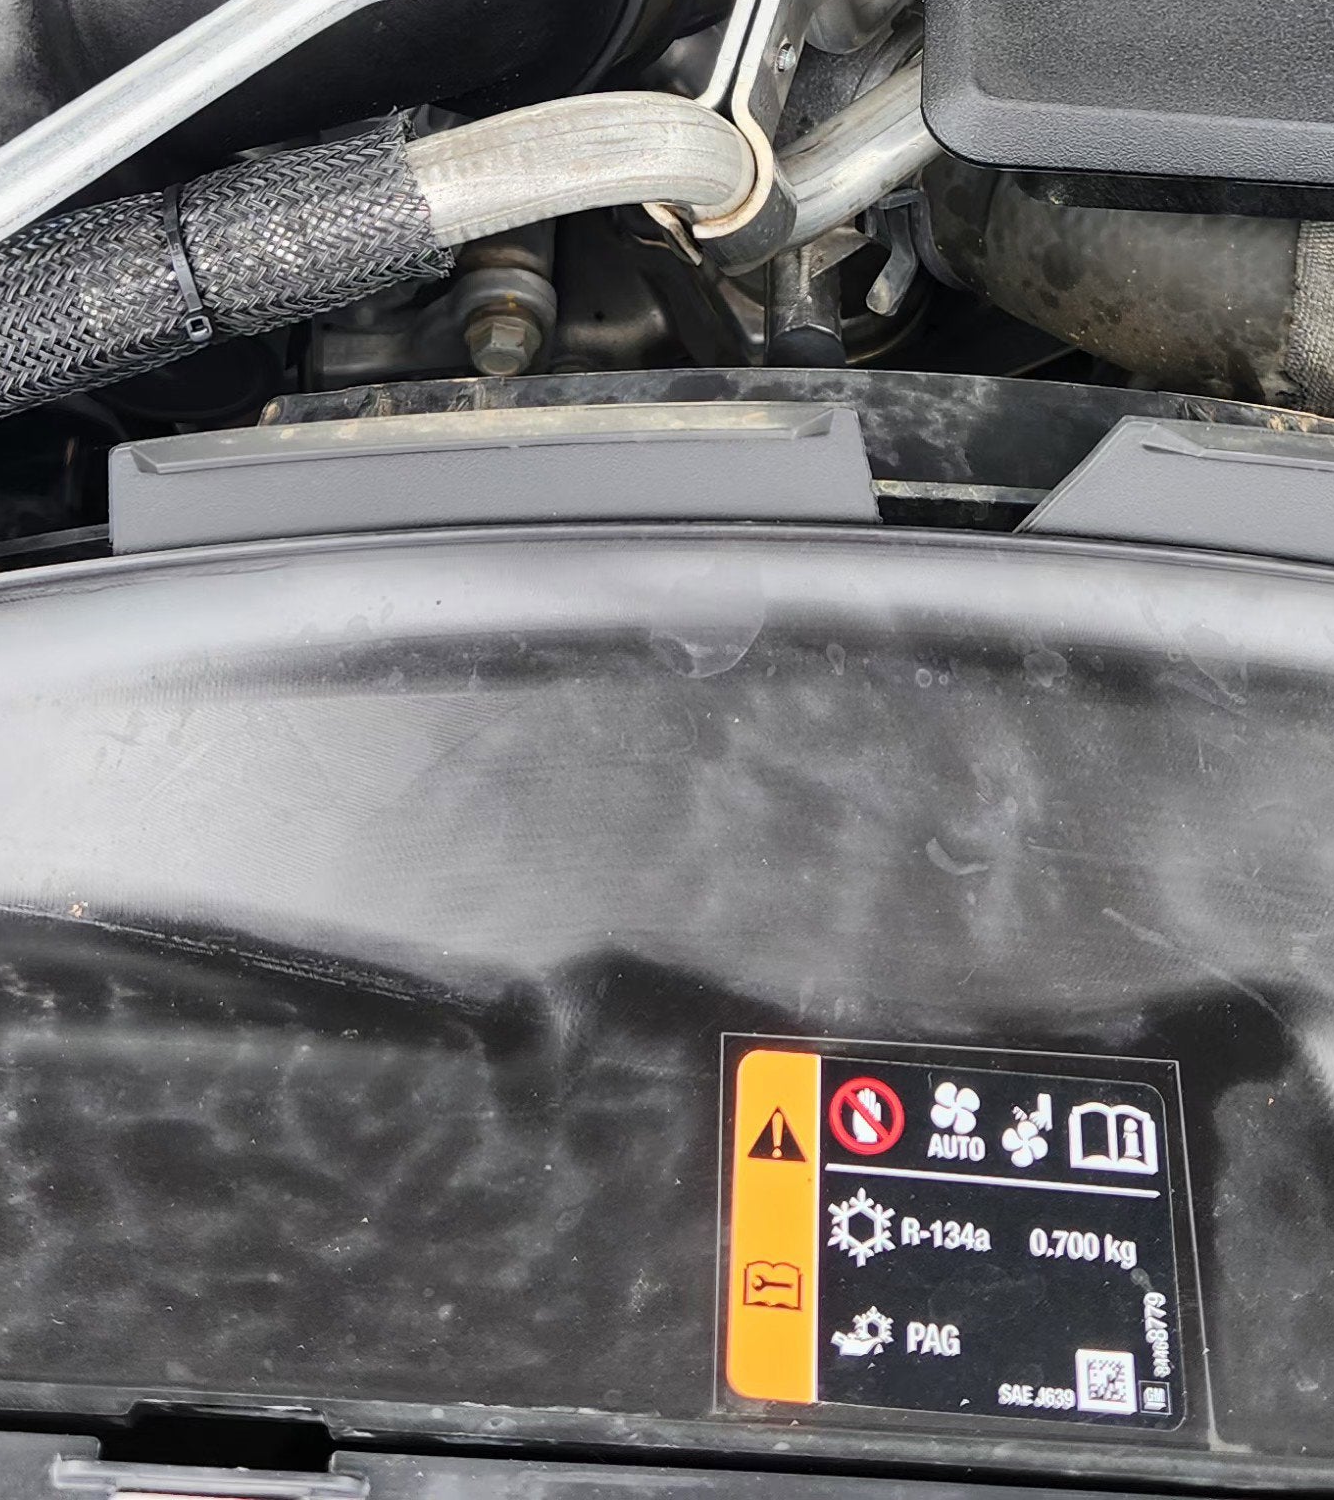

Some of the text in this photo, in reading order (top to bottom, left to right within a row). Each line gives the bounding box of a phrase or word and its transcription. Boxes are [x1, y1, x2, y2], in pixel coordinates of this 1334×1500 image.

[927, 1132, 986, 1162] AUTO
[900, 1217, 1138, 1269] R-134a 0.700 kg
[906, 1321, 962, 1357] PAG
[998, 1383, 1076, 1410] SAE J639
[1143, 1386, 1167, 1402] GM
